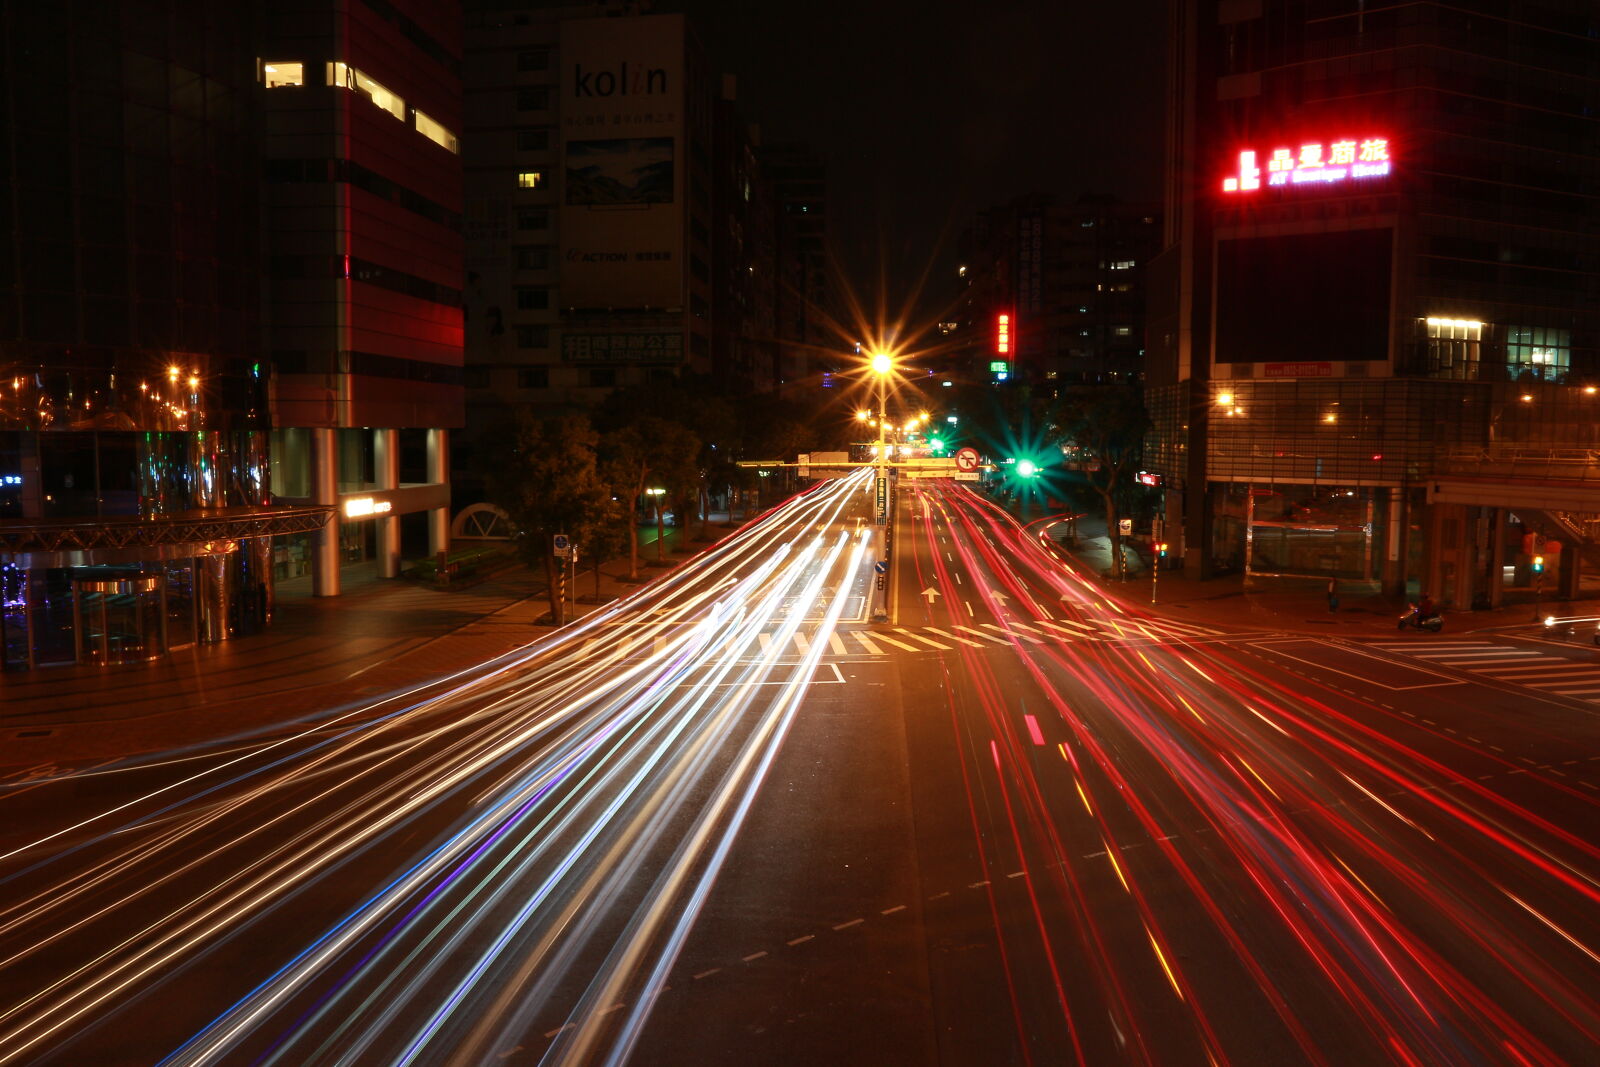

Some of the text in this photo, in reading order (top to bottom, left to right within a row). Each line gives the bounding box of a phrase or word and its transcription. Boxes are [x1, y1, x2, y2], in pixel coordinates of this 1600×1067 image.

[575, 61, 667, 97] kolin
[1269, 171, 1288, 185] AT
[581, 251, 628, 262] ACTION
[563, 335, 592, 360] 租
